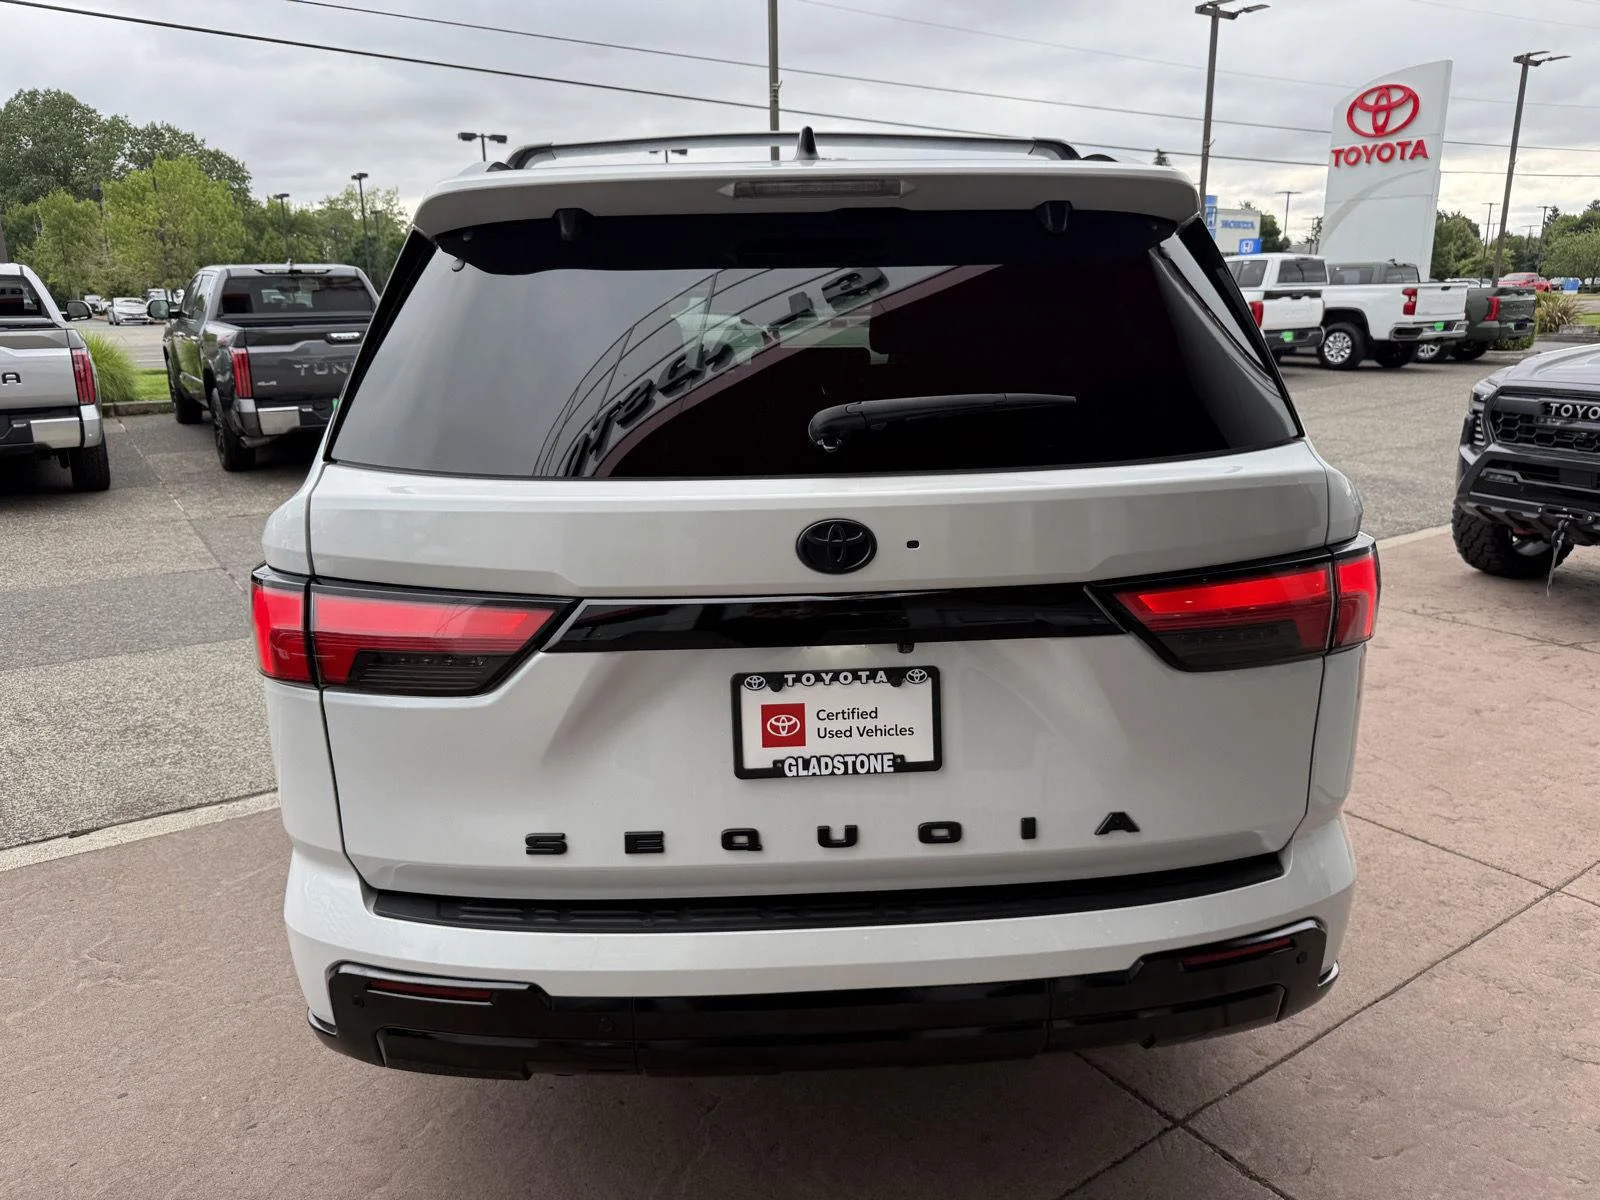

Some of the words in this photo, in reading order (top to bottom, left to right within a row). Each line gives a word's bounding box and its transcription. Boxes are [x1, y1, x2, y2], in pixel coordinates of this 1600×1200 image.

[1331, 139, 1430, 168] TOYOTA
[293, 361, 354, 376] TUN
[1550, 402, 1600, 420] TOYO
[784, 670, 889, 688] TOYOTA
[816, 706, 878, 722] Certified
[817, 725, 853, 739] Used
[857, 724, 915, 738] Vehicles
[784, 753, 895, 777] GLADSTONE
[525, 811, 1139, 855] SEQUOIA
